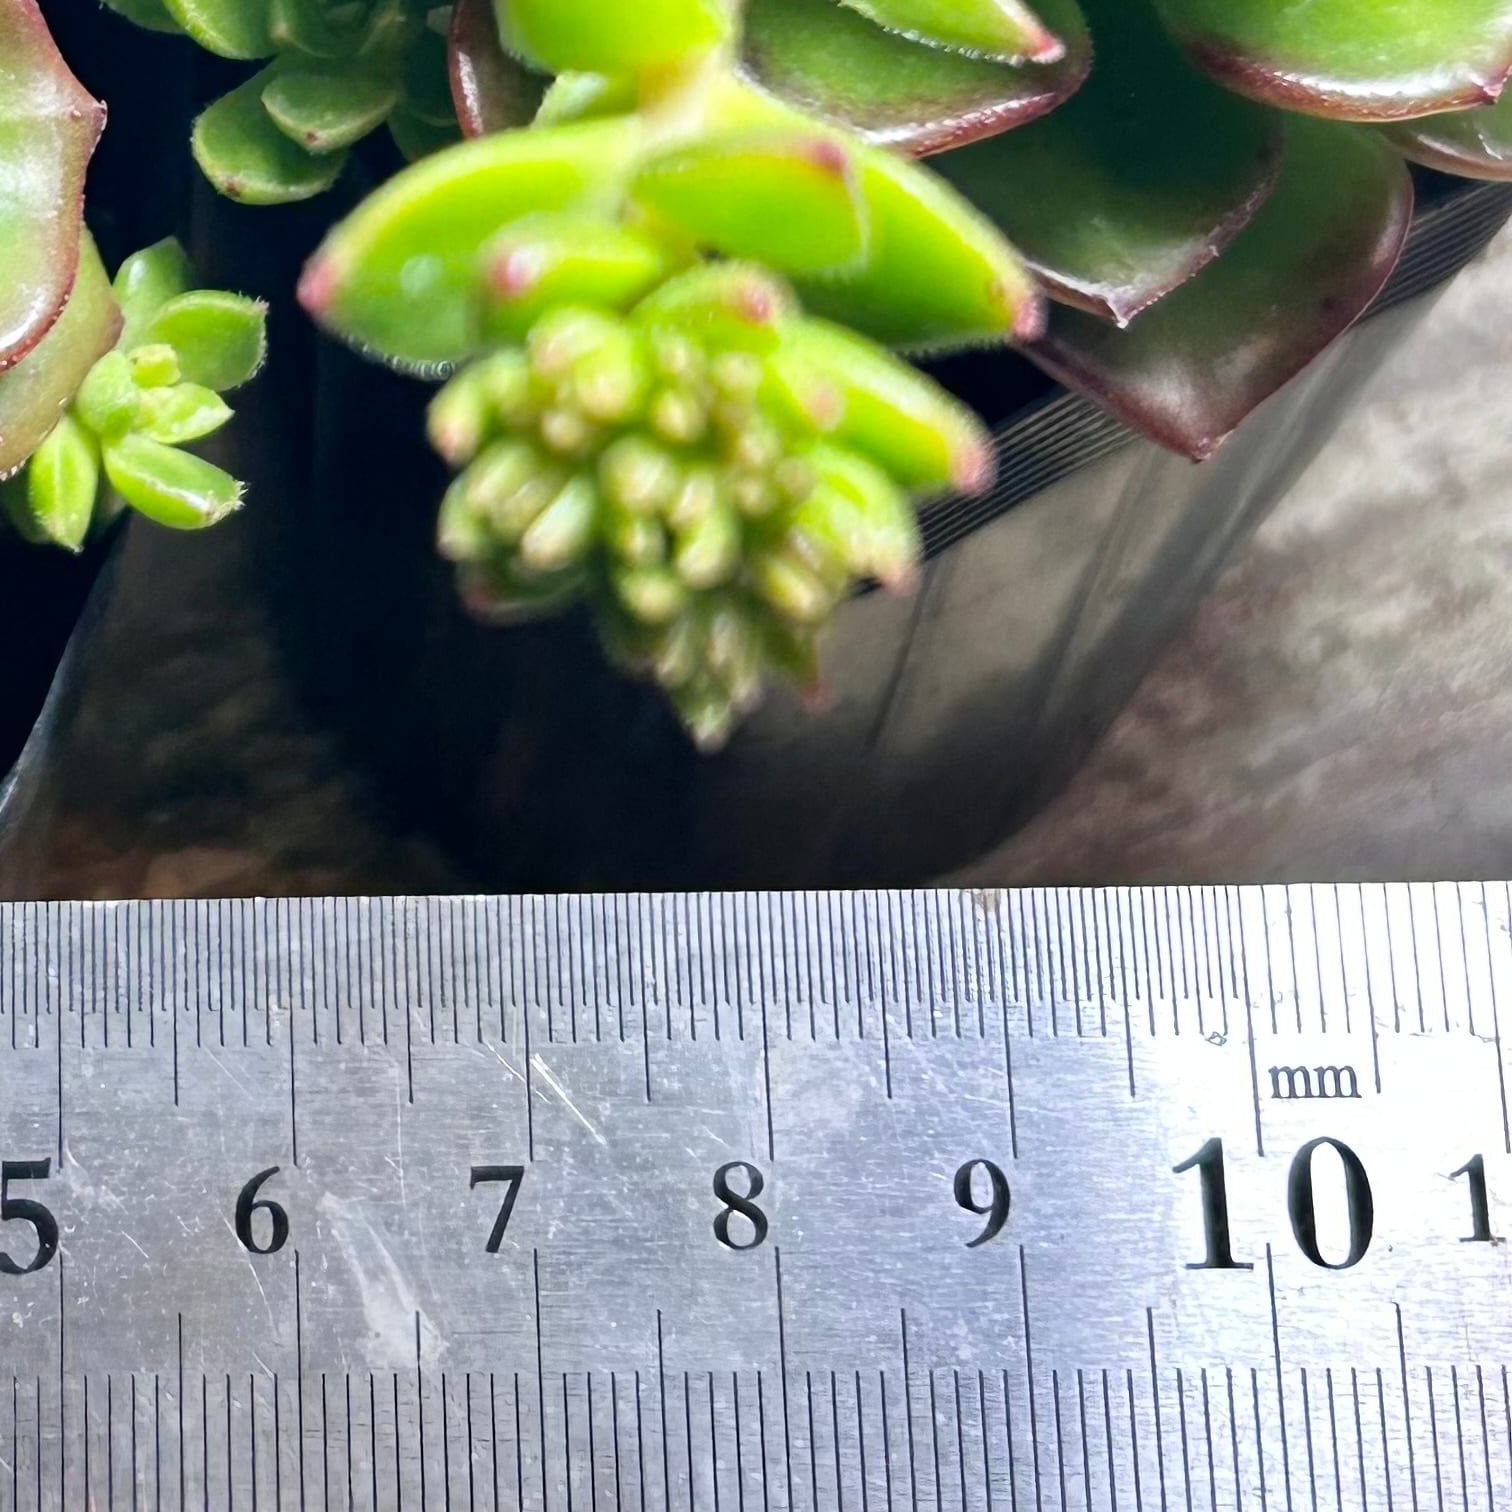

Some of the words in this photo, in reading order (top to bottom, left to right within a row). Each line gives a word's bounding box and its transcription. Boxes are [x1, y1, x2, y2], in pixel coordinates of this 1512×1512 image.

[1269, 1064, 1363, 1099] mm
[235, 1166, 290, 1255] 6
[470, 1165, 525, 1253] 7
[712, 1160, 769, 1251] 8
[953, 1158, 1012, 1248] 9
[1172, 1136, 1376, 1271] 10
